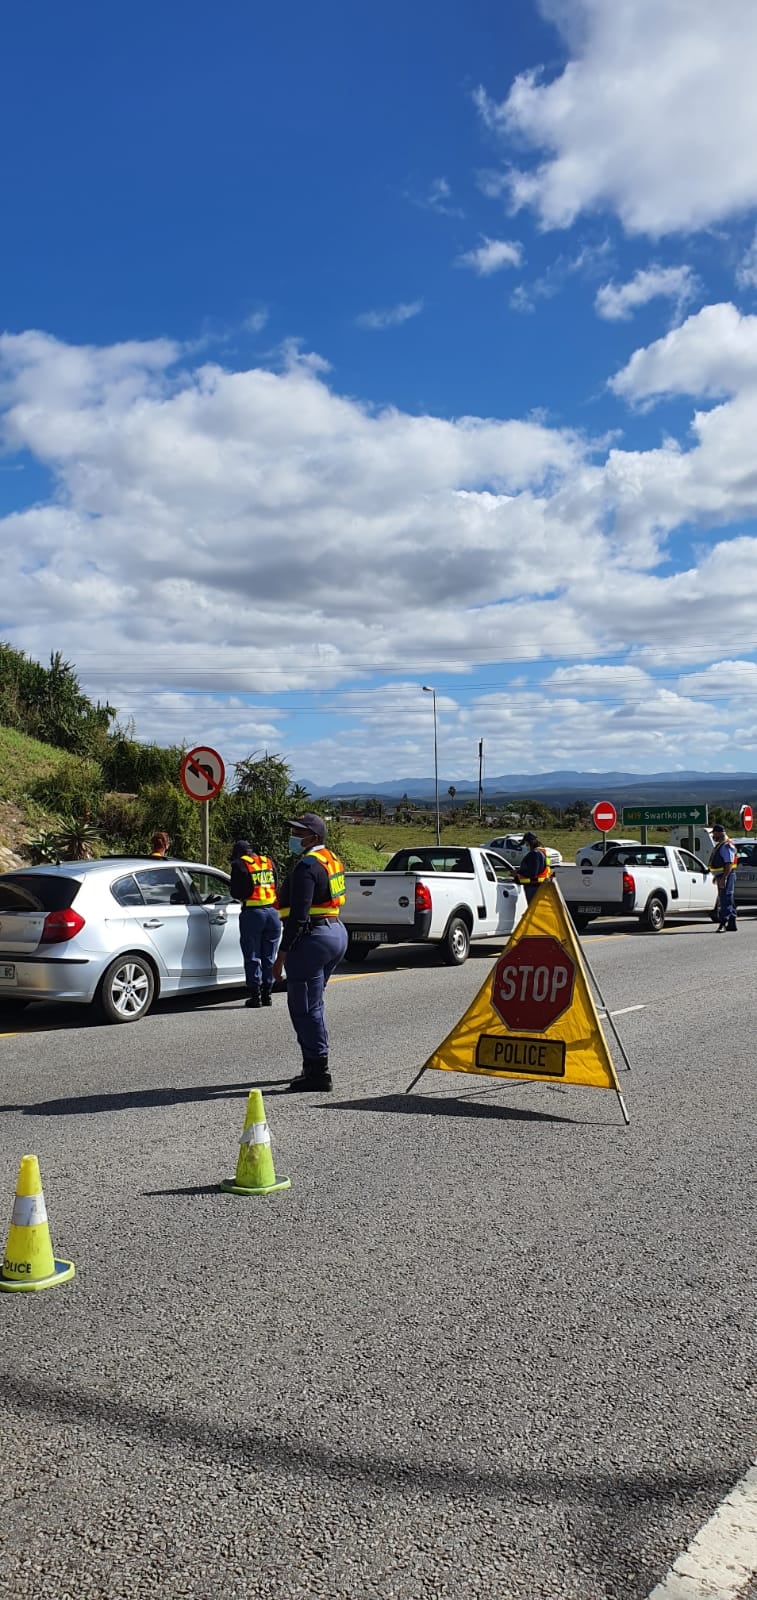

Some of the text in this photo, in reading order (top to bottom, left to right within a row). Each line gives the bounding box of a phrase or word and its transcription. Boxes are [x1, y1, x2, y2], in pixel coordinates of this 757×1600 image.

[644, 810, 688, 821] Swartkops
[251, 871, 275, 885] POLICE
[499, 965, 568, 1002] STOP
[493, 1041, 547, 1067] POLICE
[5, 1260, 31, 1273] OLICE
